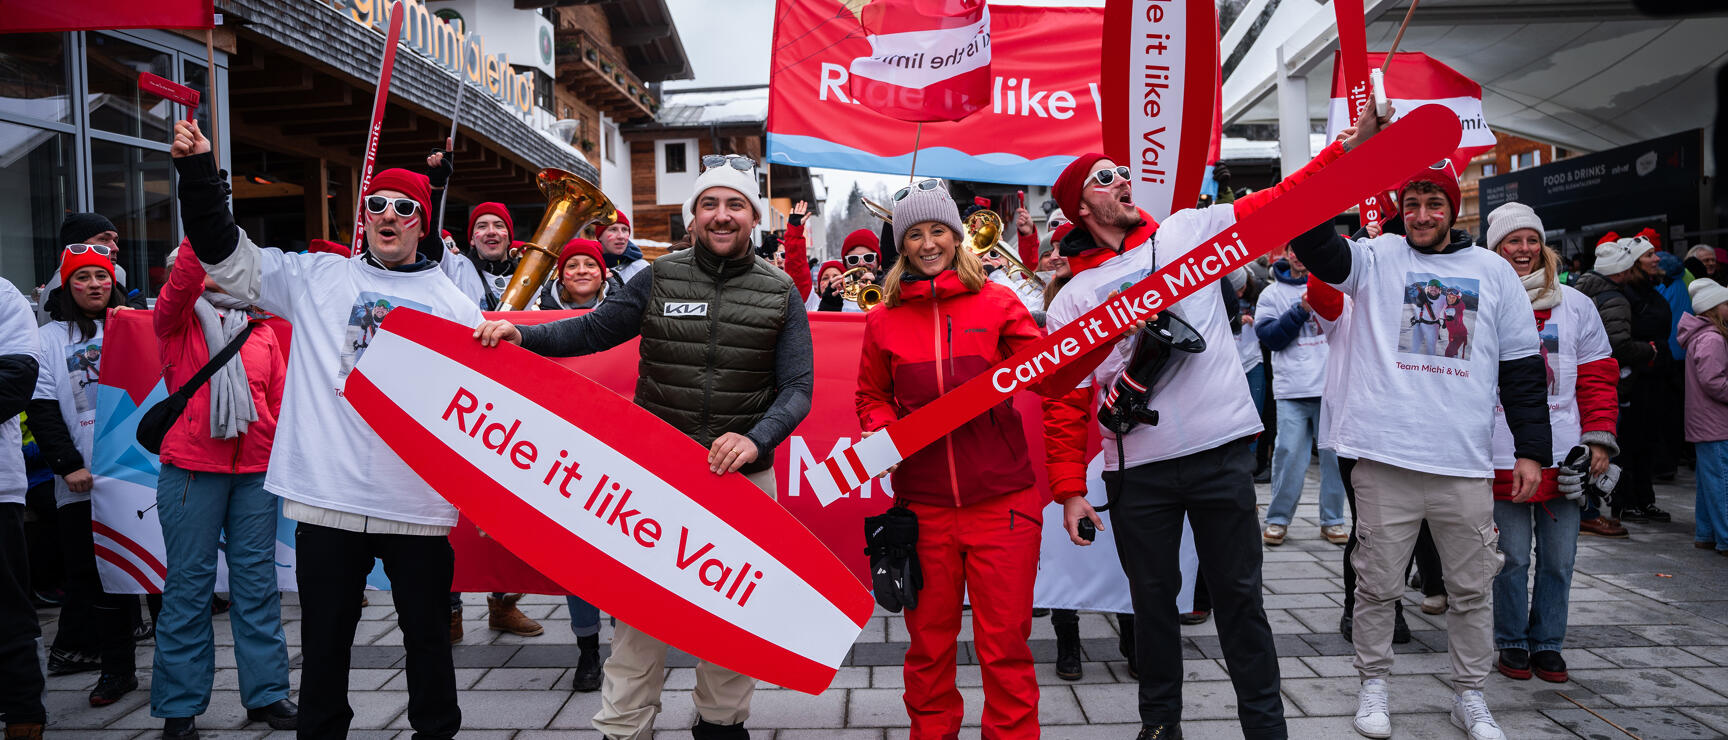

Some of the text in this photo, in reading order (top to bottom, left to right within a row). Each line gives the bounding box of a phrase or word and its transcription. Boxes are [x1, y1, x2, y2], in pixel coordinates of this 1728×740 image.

[1145, 34, 1171, 55] it
[993, 76, 1076, 119] like
[1143, 65, 1170, 118] like
[363, 121, 381, 193] the limit.
[1141, 126, 1166, 184] Vali
[1543, 172, 1566, 187] FOOD
[1567, 171, 1573, 182] &
[1574, 164, 1606, 181] DRINKS
[992, 232, 1249, 393] Carve it like Michi
[1396, 361, 1469, 378] Team Michi & Vali
[441, 386, 764, 607] Ride it like Vali
